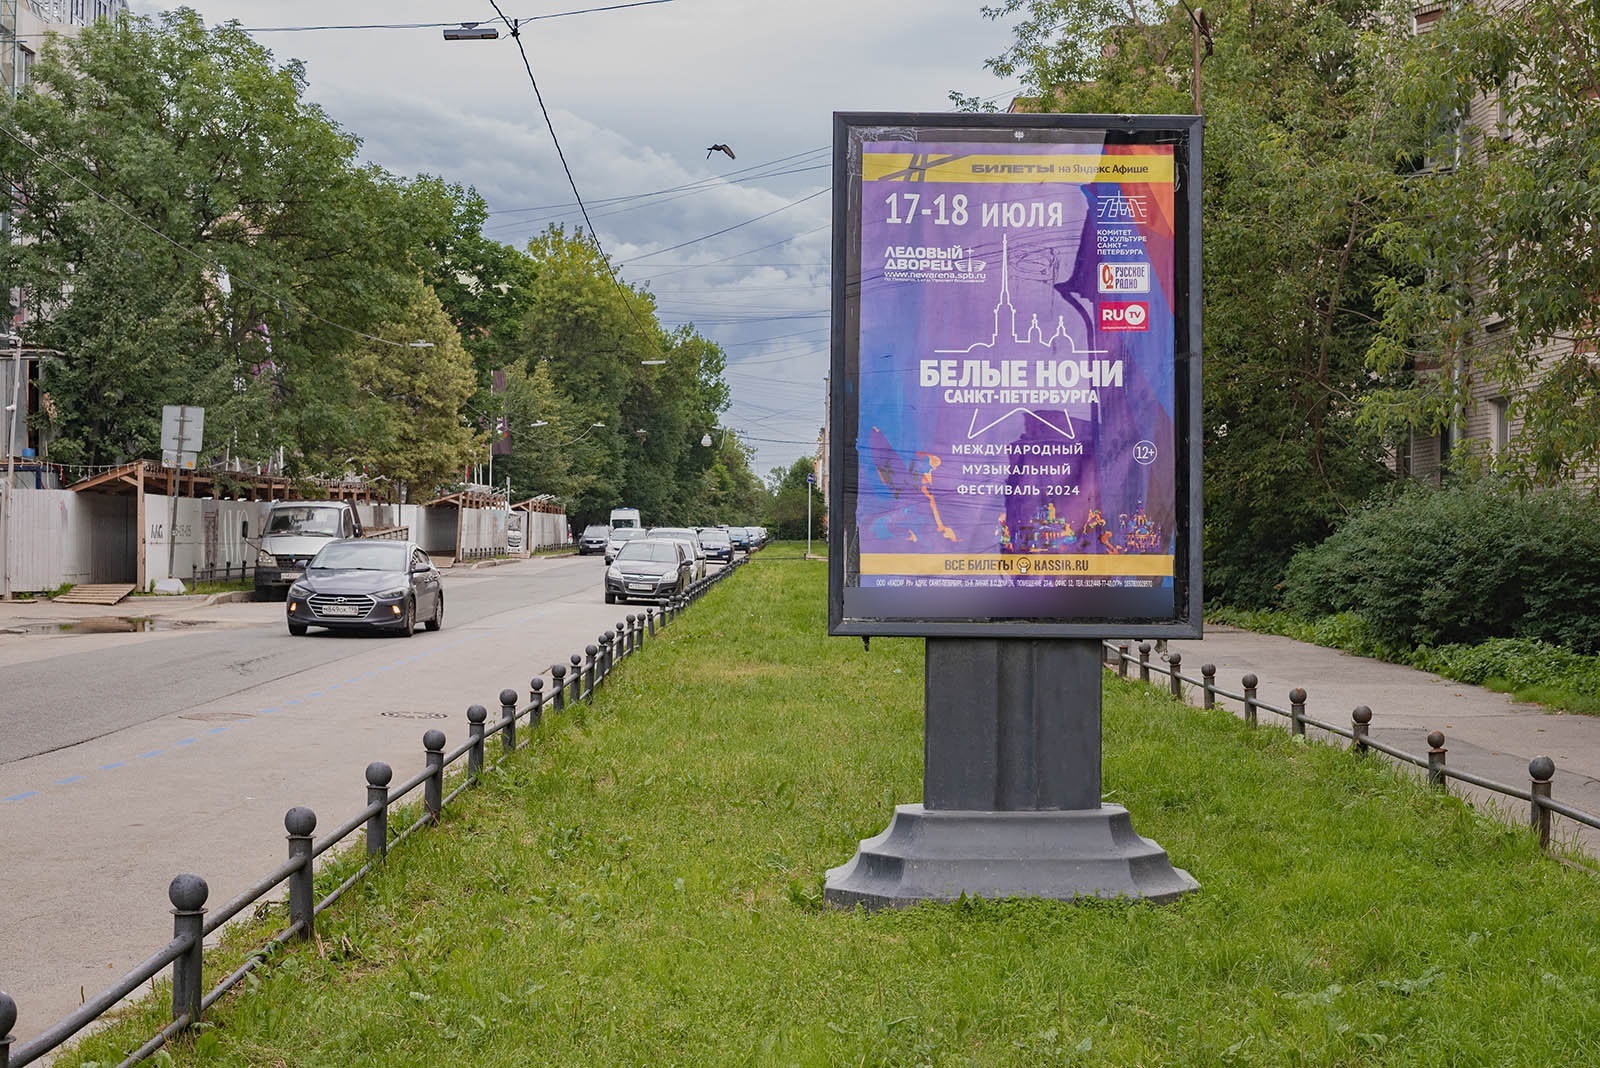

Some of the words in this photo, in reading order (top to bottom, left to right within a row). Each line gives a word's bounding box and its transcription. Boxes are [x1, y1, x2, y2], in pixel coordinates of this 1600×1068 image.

[971, 164, 1054, 173] БИЛЕТЫ
[1072, 164, 1110, 175] Яндекс
[1112, 164, 1149, 175] Афише
[885, 192, 969, 226] 17-18
[981, 202, 1063, 228] ИЮЛЯ
[884, 244, 963, 259] ЛЕДОВЫЙ
[1097, 248, 1144, 256] ПЕТЕРБУРГА
[884, 258, 953, 271] ДВОРЕЦ
[884, 271, 987, 280] www.newarena.spb.ru
[1115, 266, 1145, 278] РУССКОЕ
[1115, 278, 1138, 289] РАДИО
[1102, 309, 1125, 321] RU
[1128, 311, 1142, 319] TV
[919, 359, 1028, 387] БЕЛЫЕ
[1036, 359, 1124, 388] НОЧИ
[944, 389, 1100, 404] САНКТ-ПЕТЕРБУРГА
[952, 442, 1083, 456] МЕЖДУНАРОДНЫЙ
[1135, 445, 1155, 460] 12+
[962, 463, 1071, 475] МУЗЫКАЛЬНЫЙ
[957, 484, 1040, 496] ФЕСТИВАЛЬ
[1046, 484, 1080, 496] 2024
[944, 559, 965, 571] ВСЕ
[967, 559, 1014, 571] БИЛЕТЫ
[1034, 559, 1089, 571] KASSIR.RU
